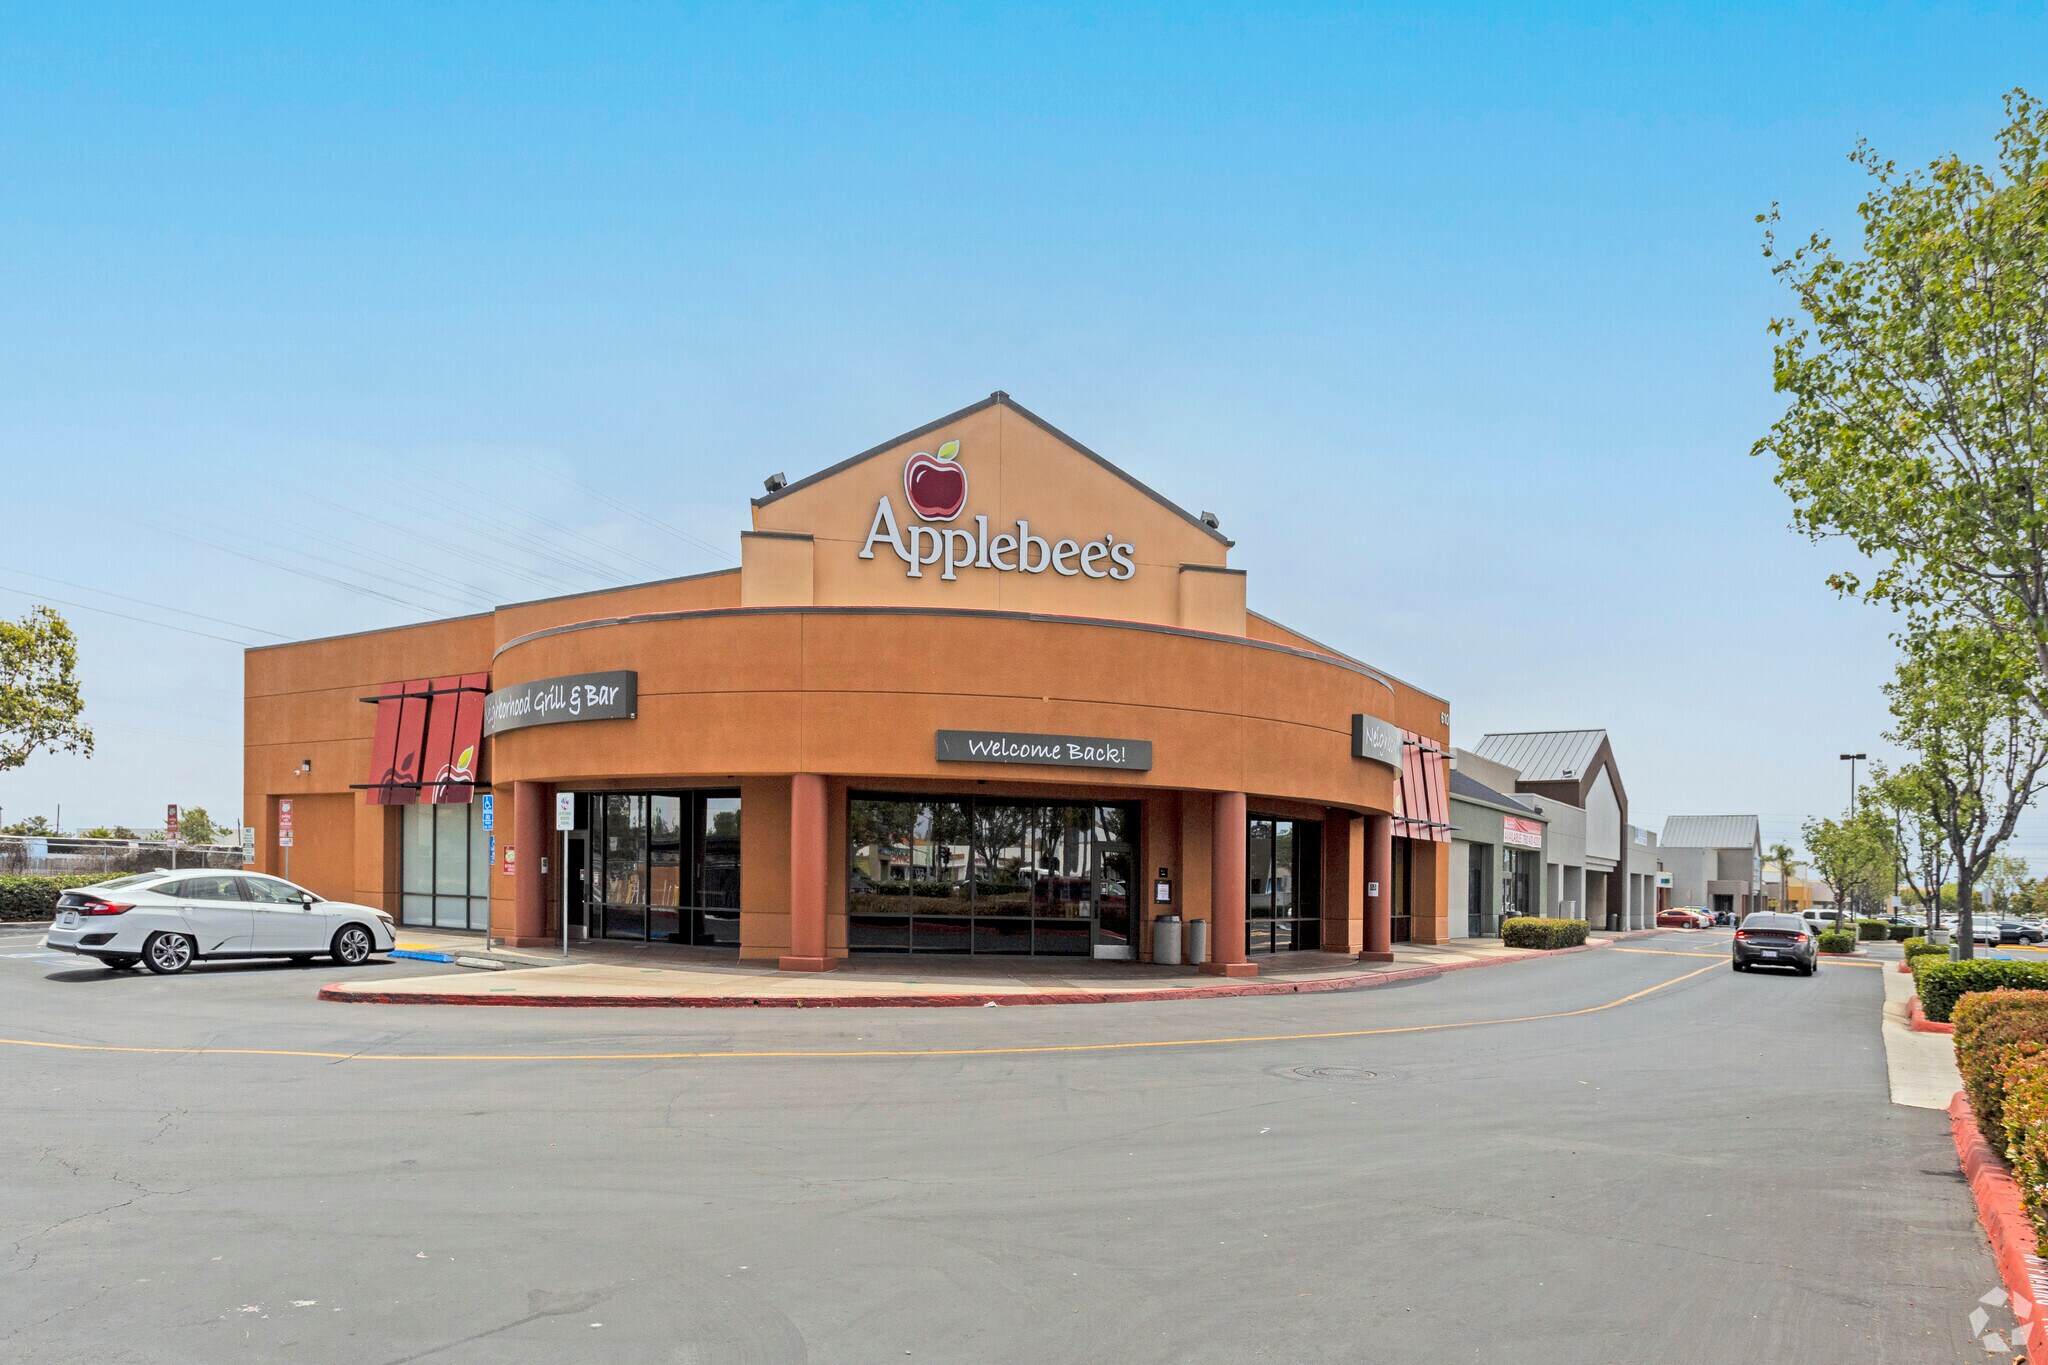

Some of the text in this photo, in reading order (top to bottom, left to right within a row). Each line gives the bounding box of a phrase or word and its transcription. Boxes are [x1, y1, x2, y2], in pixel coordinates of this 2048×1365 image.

[858, 495, 1137, 581] Applebee's
[534, 684, 566, 716] Grill
[569, 685, 581, 715] &
[584, 684, 619, 706] Bar
[968, 738, 1126, 763] Welcome Back!
